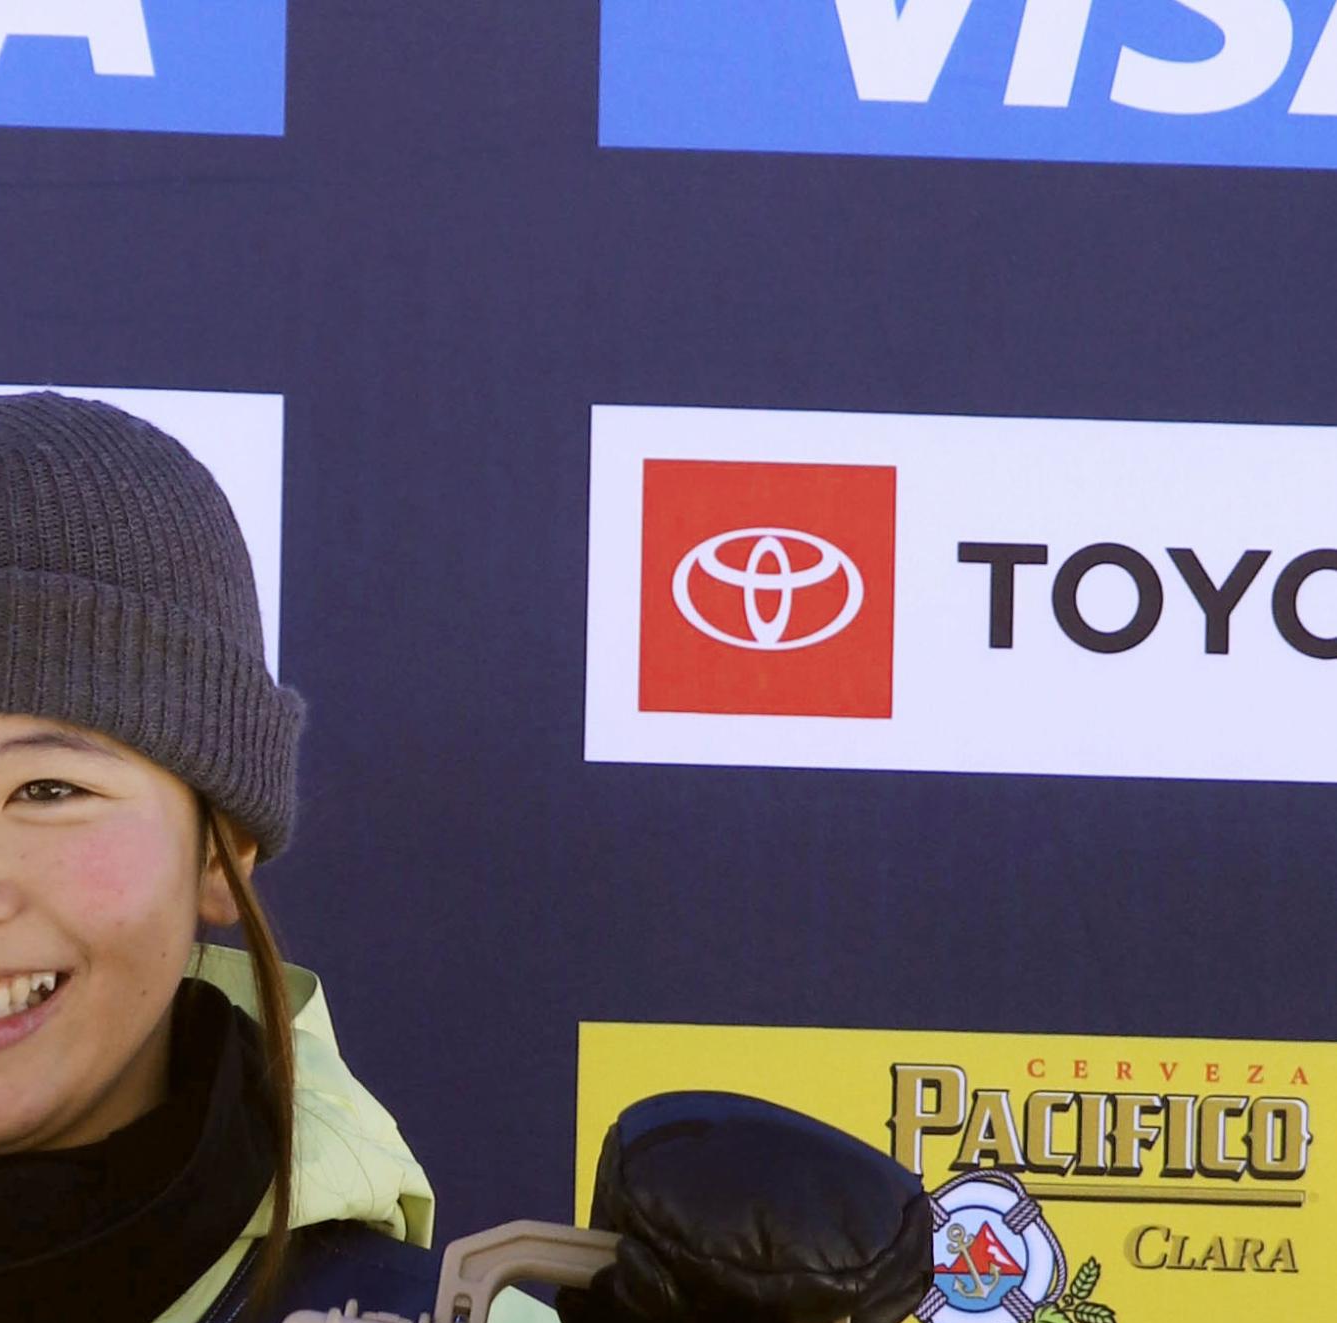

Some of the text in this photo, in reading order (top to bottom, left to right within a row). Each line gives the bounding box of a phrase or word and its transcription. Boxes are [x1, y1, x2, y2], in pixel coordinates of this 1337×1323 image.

[957, 541, 1337, 661] TOYO
[1027, 1058, 1309, 1086] CERVEZA
[886, 1063, 1313, 1180] PACIFICO
[1124, 1224, 1299, 1274] CLARA
